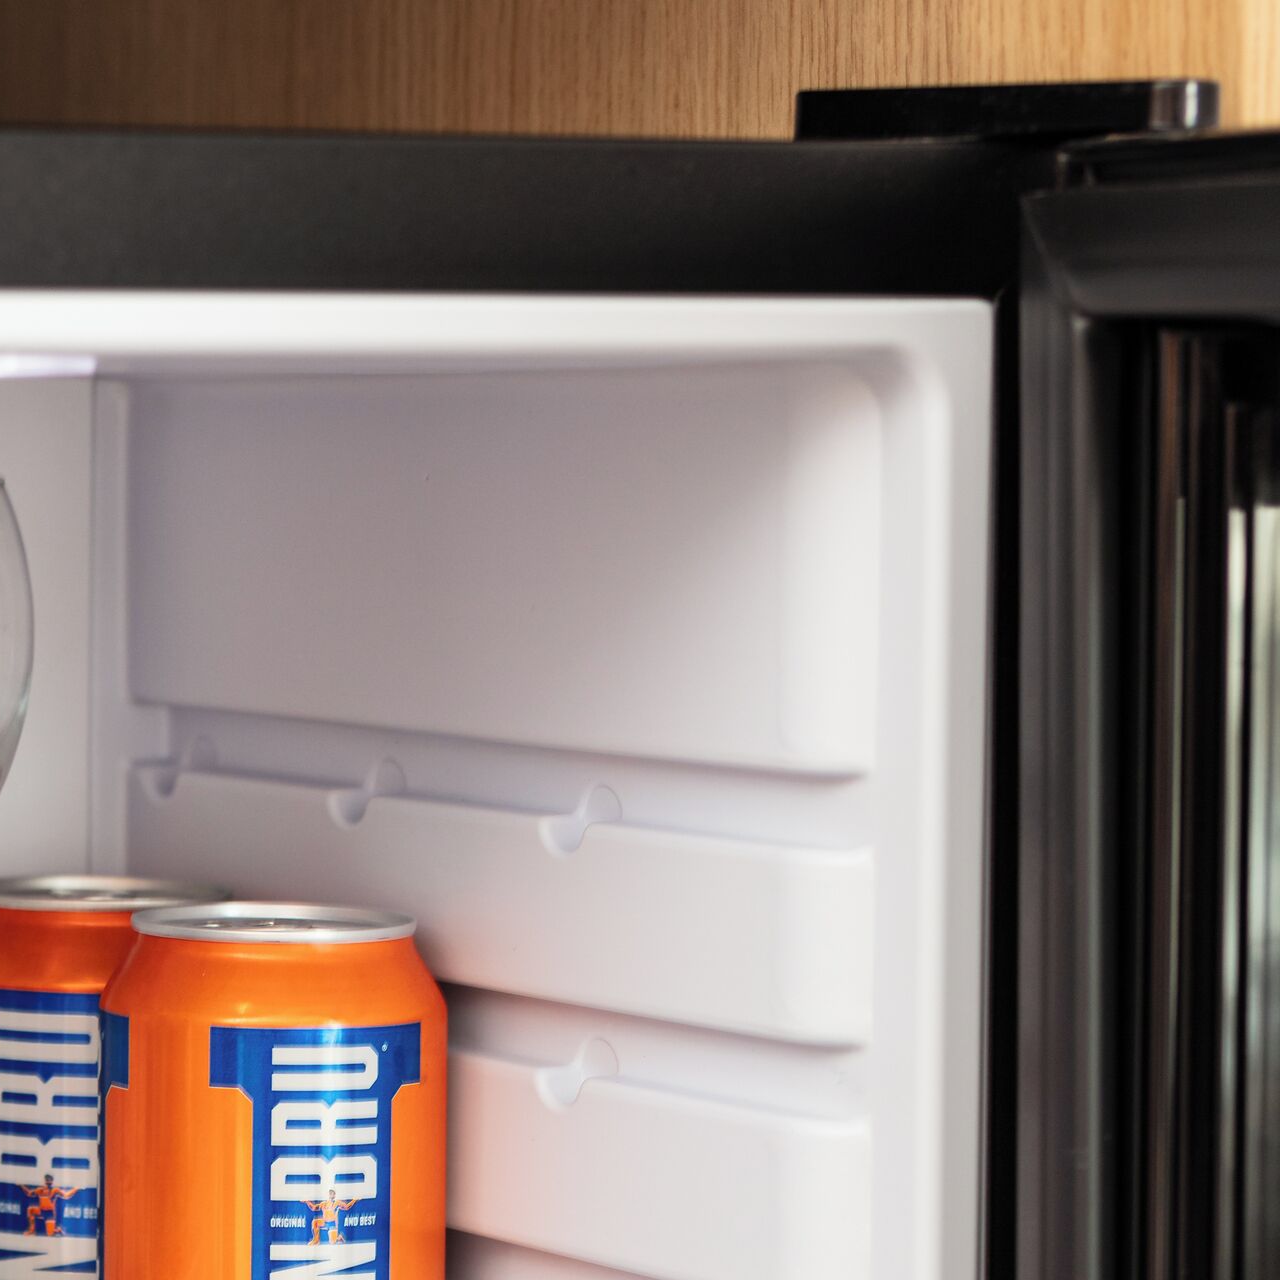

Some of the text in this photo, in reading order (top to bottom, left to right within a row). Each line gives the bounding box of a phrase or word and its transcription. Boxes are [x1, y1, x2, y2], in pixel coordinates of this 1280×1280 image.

[269, 1044, 380, 1203] BRU
[82, 1206, 99, 1219] BES
[269, 1213, 377, 1228] ORIGINAL AND BEST
